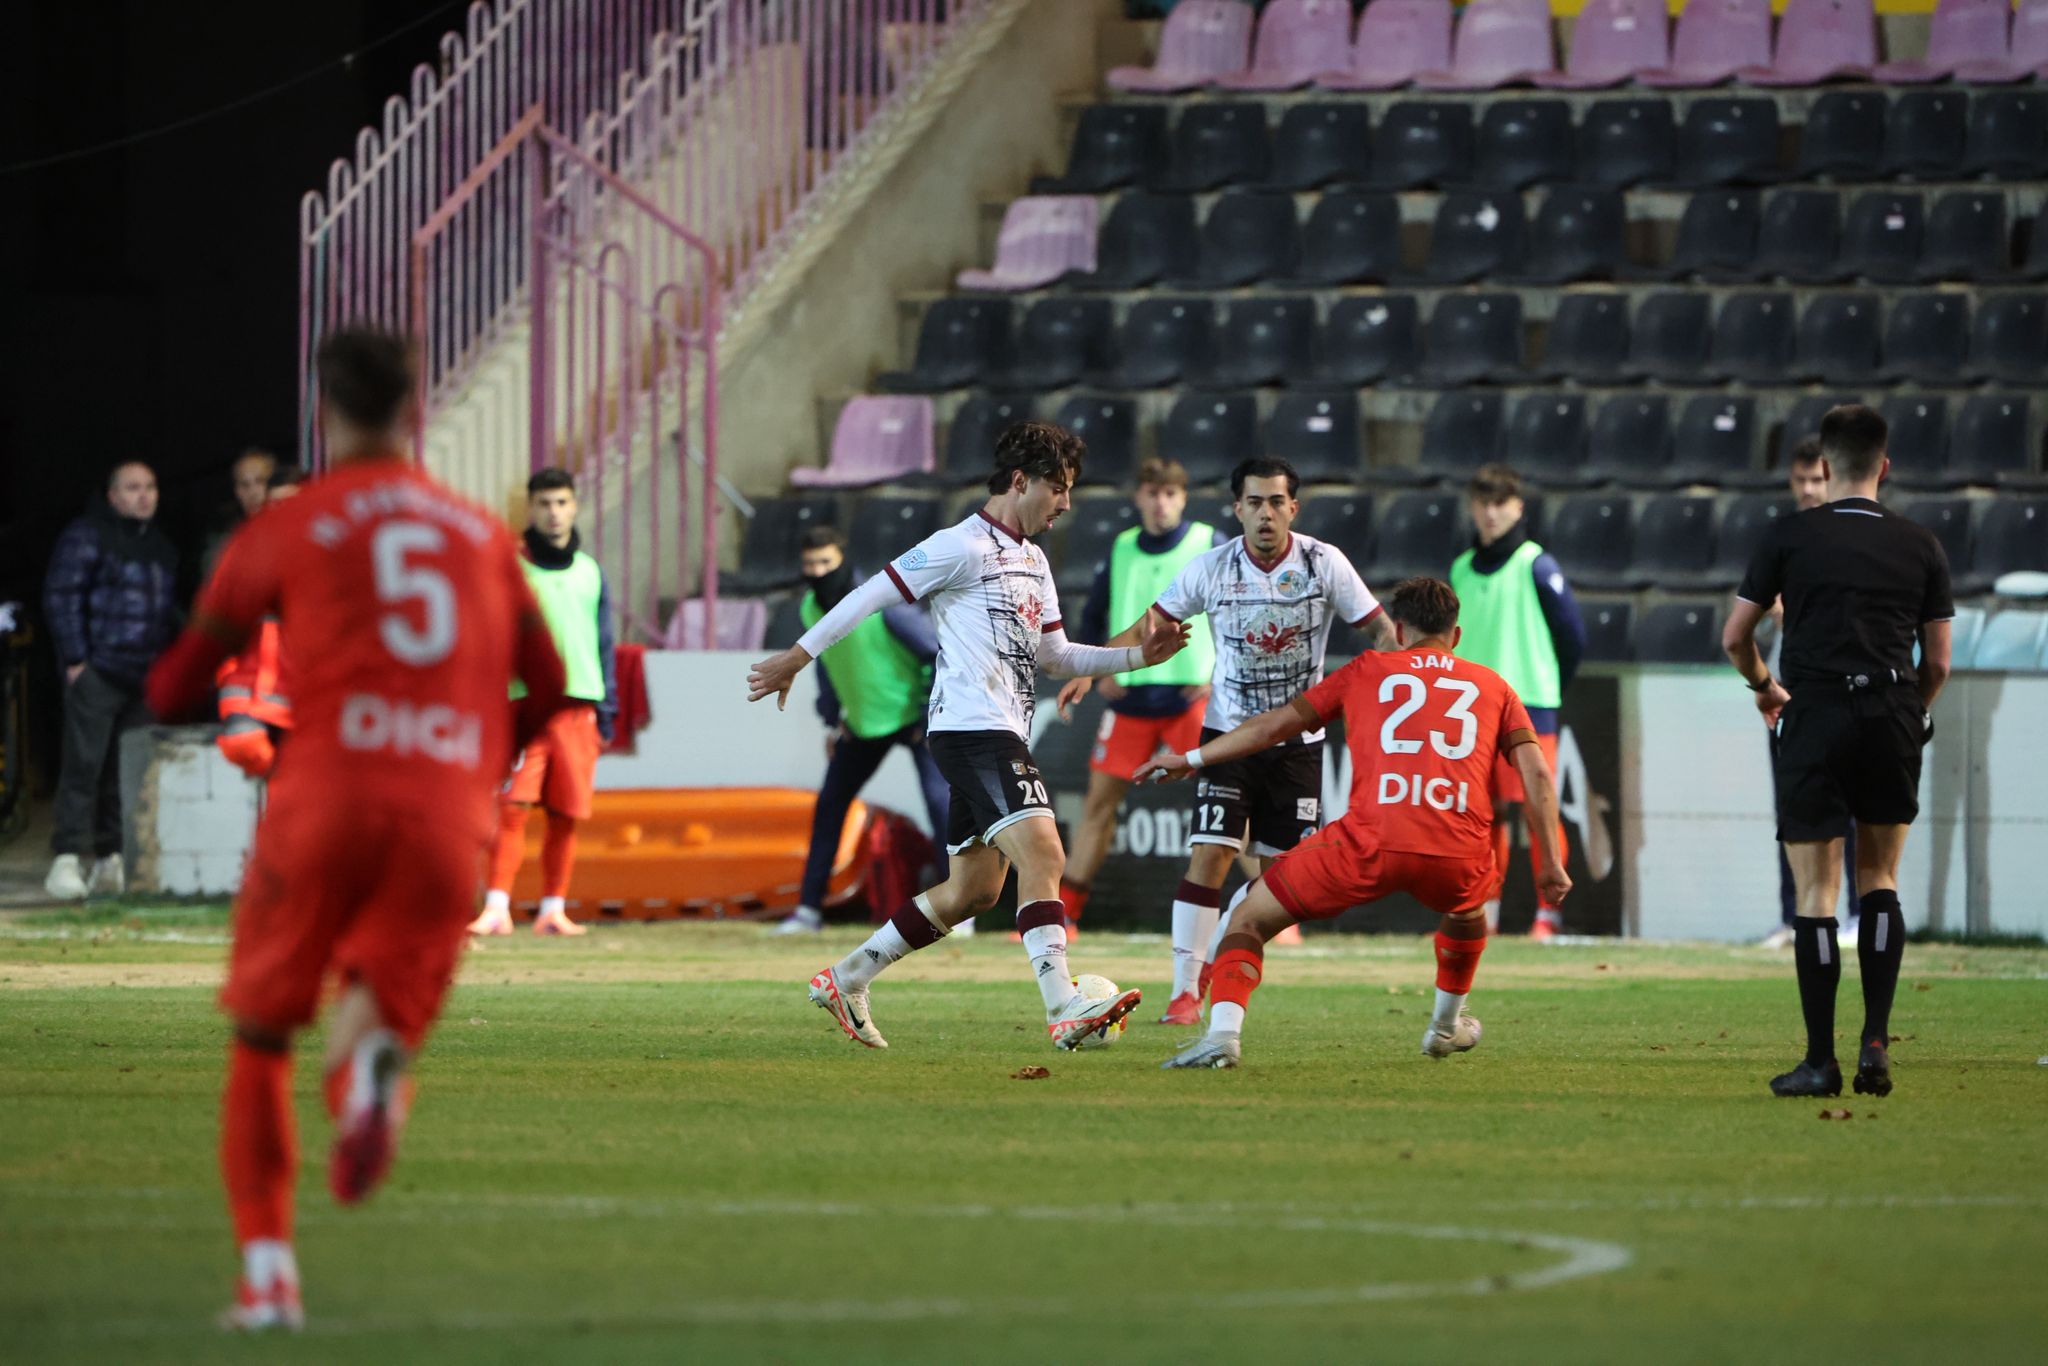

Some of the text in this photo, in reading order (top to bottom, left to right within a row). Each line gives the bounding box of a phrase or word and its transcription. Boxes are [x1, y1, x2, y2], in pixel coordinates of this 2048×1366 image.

[371, 521, 458, 667] 5
[1410, 655, 1456, 672] JAN
[339, 692, 484, 770] DIGI
[1378, 673, 1480, 760] 23
[1017, 780, 1048, 805] 20
[1377, 773, 1469, 813] DIGI
[1199, 803, 1225, 831] 12
